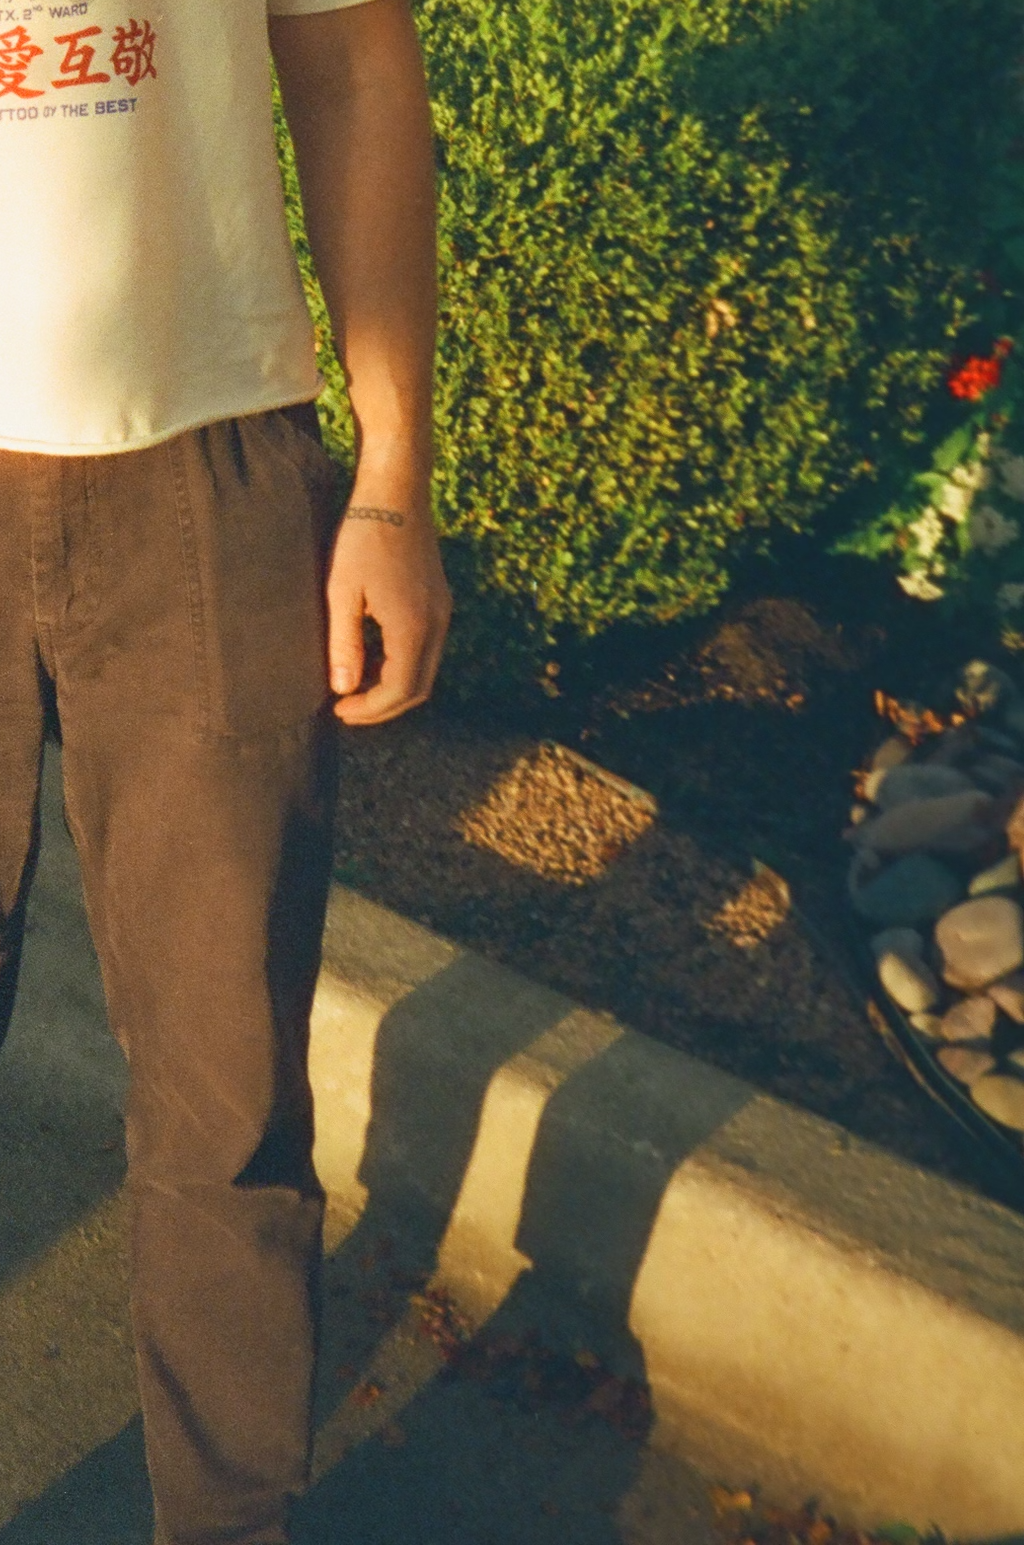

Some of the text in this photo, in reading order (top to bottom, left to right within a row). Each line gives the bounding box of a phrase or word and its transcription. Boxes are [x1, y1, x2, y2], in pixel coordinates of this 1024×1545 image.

[48, 2, 89, 19] WARD
[59, 103, 90, 118] THE
[94, 97, 139, 115] BEST
